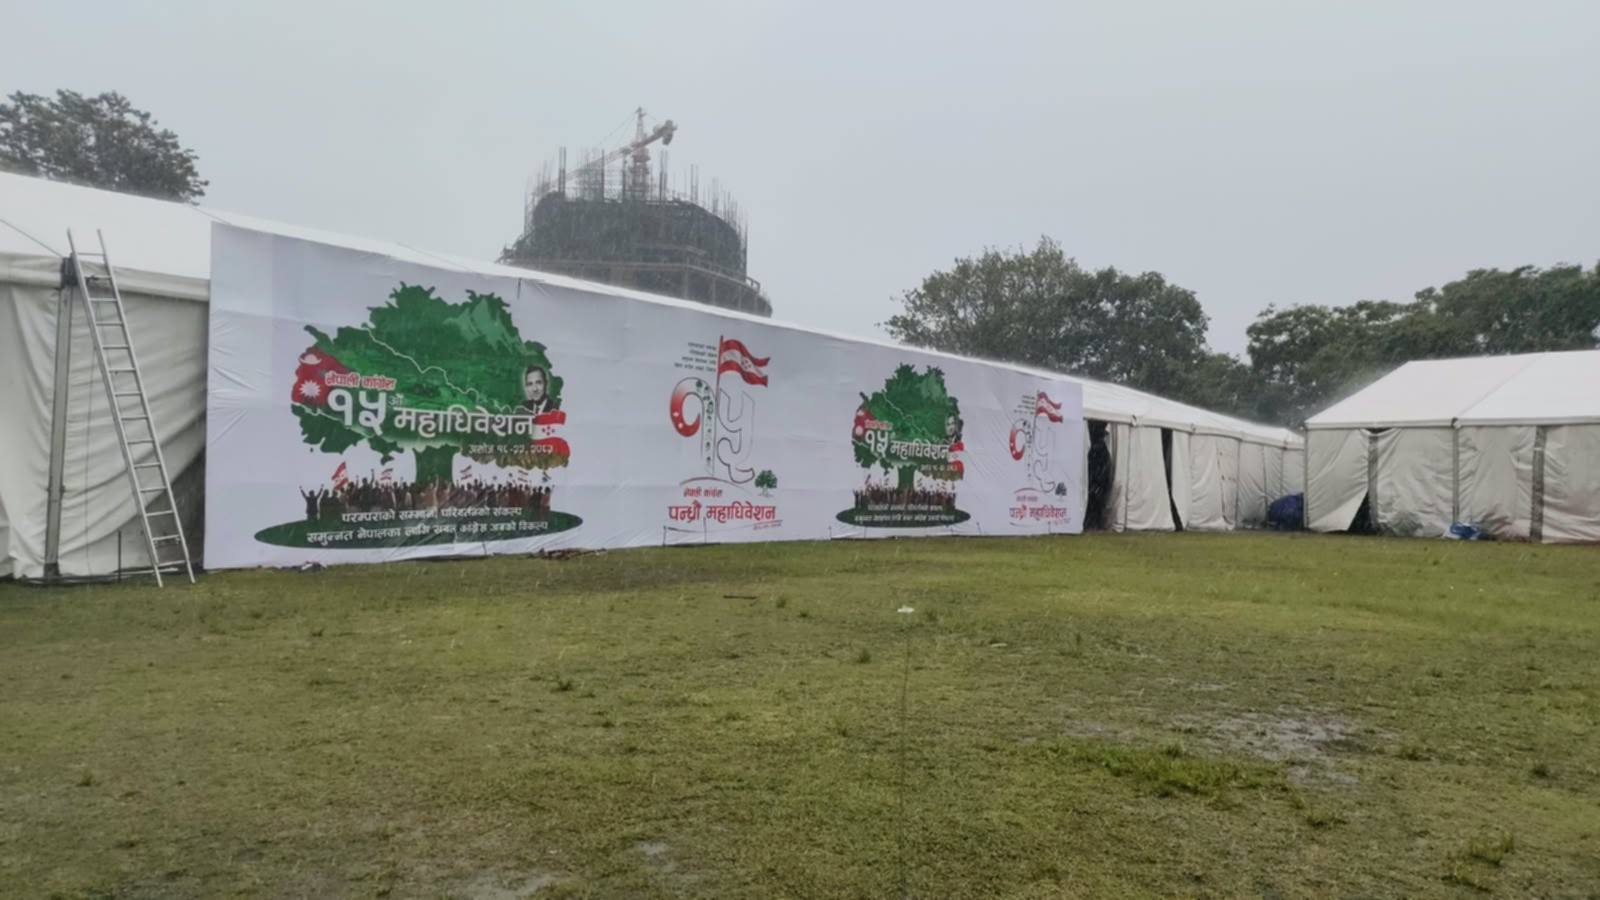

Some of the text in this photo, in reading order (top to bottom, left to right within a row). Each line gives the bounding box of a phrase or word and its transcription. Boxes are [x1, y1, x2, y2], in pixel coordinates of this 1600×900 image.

[393, 404, 535, 438] महाधिवेशन
[890, 439, 950, 460] महाधिवेशन
[341, 508, 396, 523] परम्पराको
[706, 500, 776, 524] महाधिवेशन
